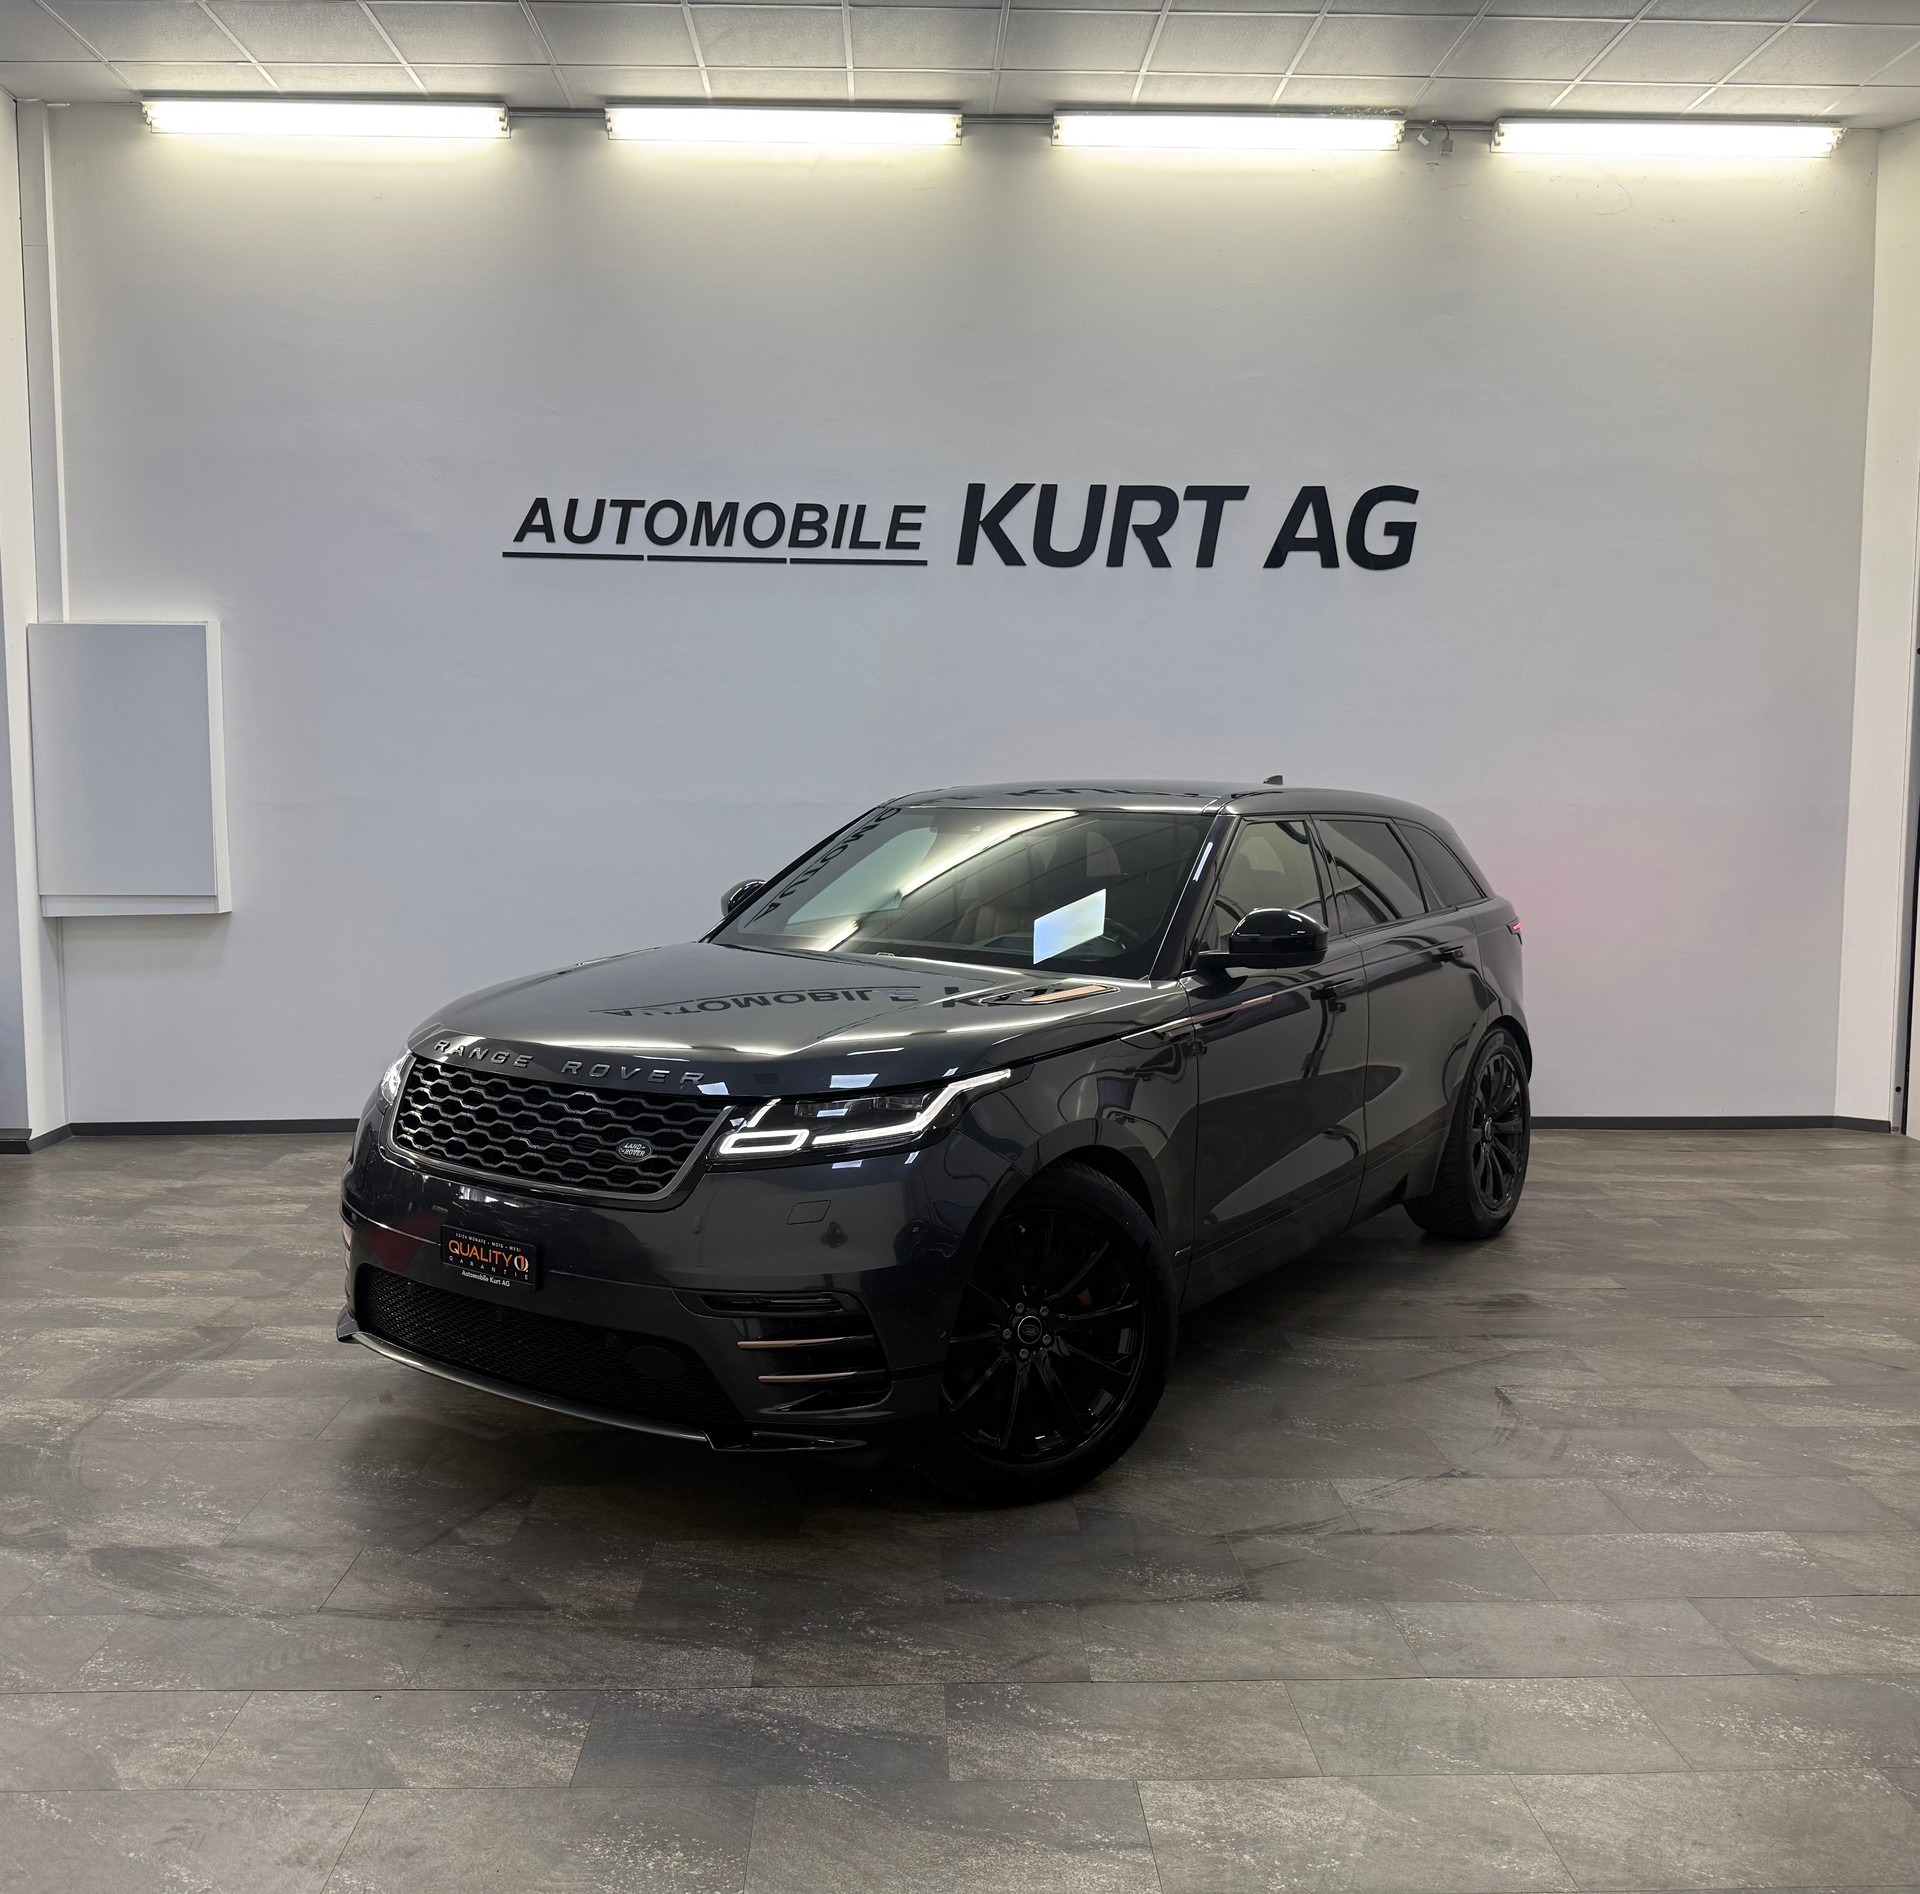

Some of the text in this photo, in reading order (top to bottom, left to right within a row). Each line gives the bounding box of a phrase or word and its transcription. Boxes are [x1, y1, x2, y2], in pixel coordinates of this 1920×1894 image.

[513, 482, 1420, 571] AUTOMOBILE KURT AG
[434, 1039, 705, 1088] RANGE ROVER
[449, 1255, 529, 1280] GARANTIE
[461, 1270, 489, 1282] Automobile
[489, 1277, 501, 1286] Kurt
